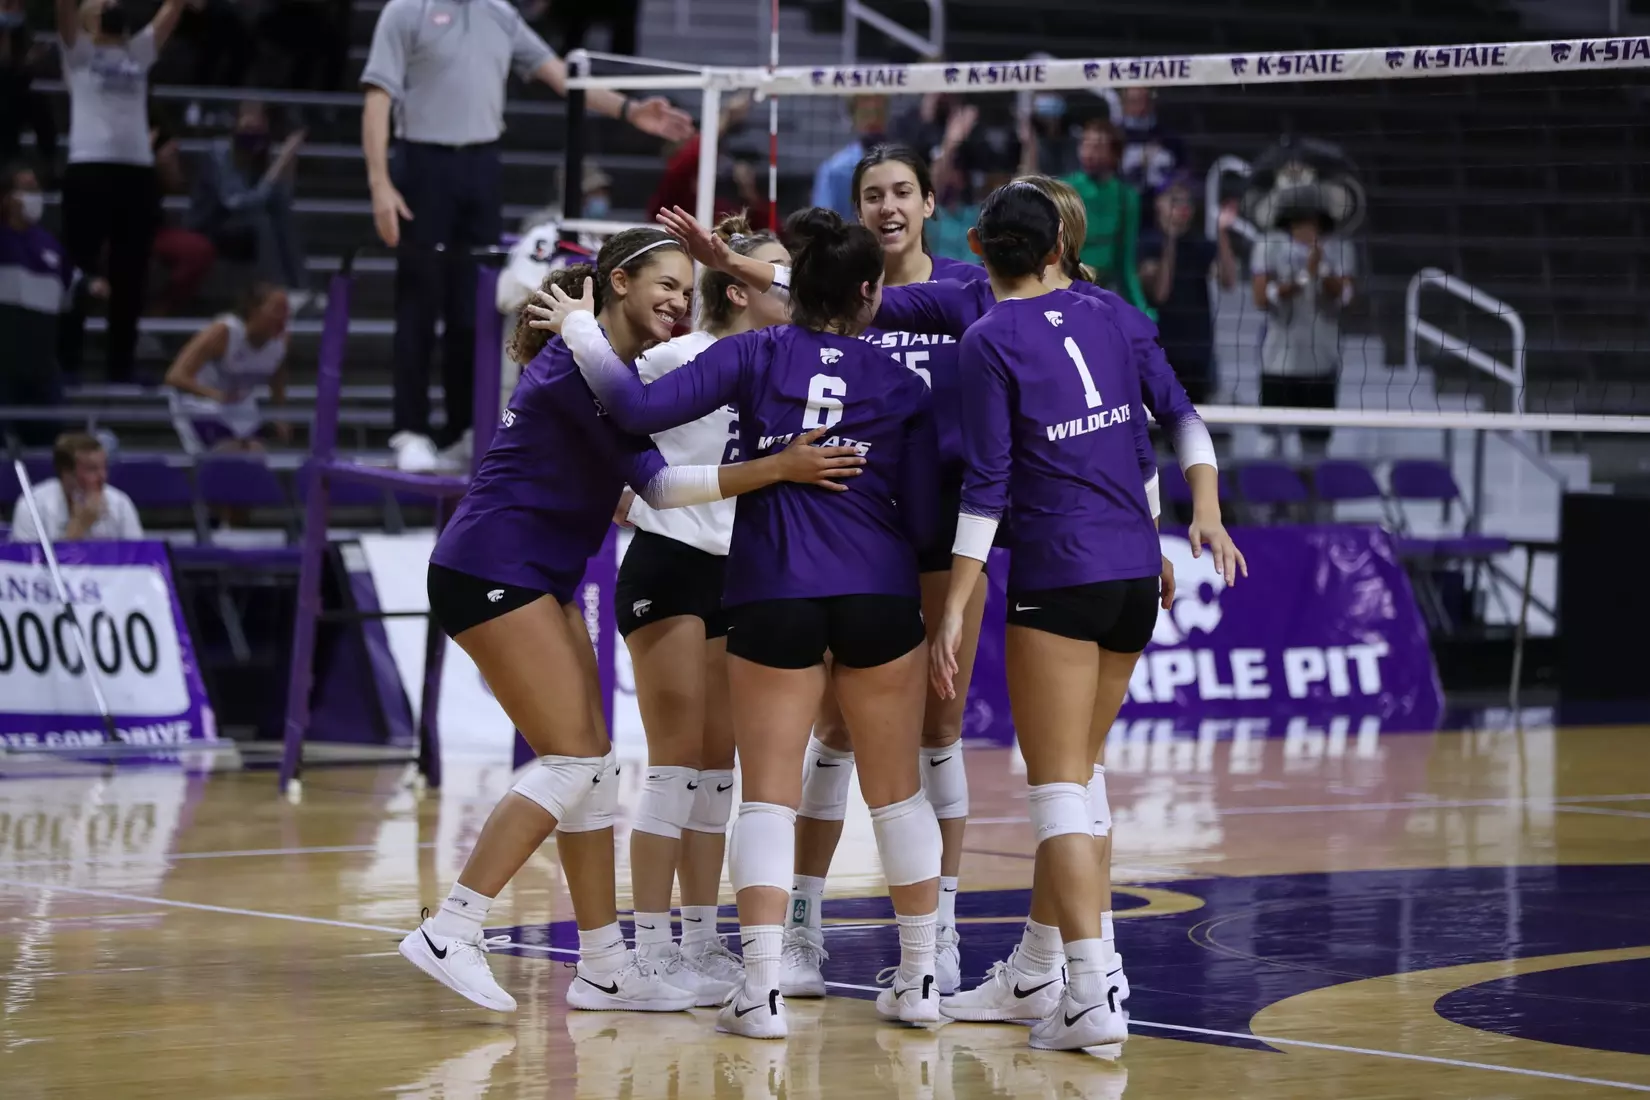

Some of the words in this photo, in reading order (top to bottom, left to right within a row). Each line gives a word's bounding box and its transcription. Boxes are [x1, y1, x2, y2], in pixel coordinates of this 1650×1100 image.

[833, 69, 907, 87] K-STATE
[968, 65, 1046, 85] K-STATE
[1109, 59, 1191, 80] K-STATE
[1257, 53, 1345, 76] K-STATE
[1413, 46, 1506, 69] K-STATE
[1580, 39, 1650, 62] K-STA
[890, 350, 932, 390] 5
[1064, 336, 1103, 409] 1
[801, 373, 847, 430] 6
[1046, 404, 1131, 442] WILDCATS
[0, 576, 102, 605] NSAS
[1283, 641, 1389, 700] PIT
